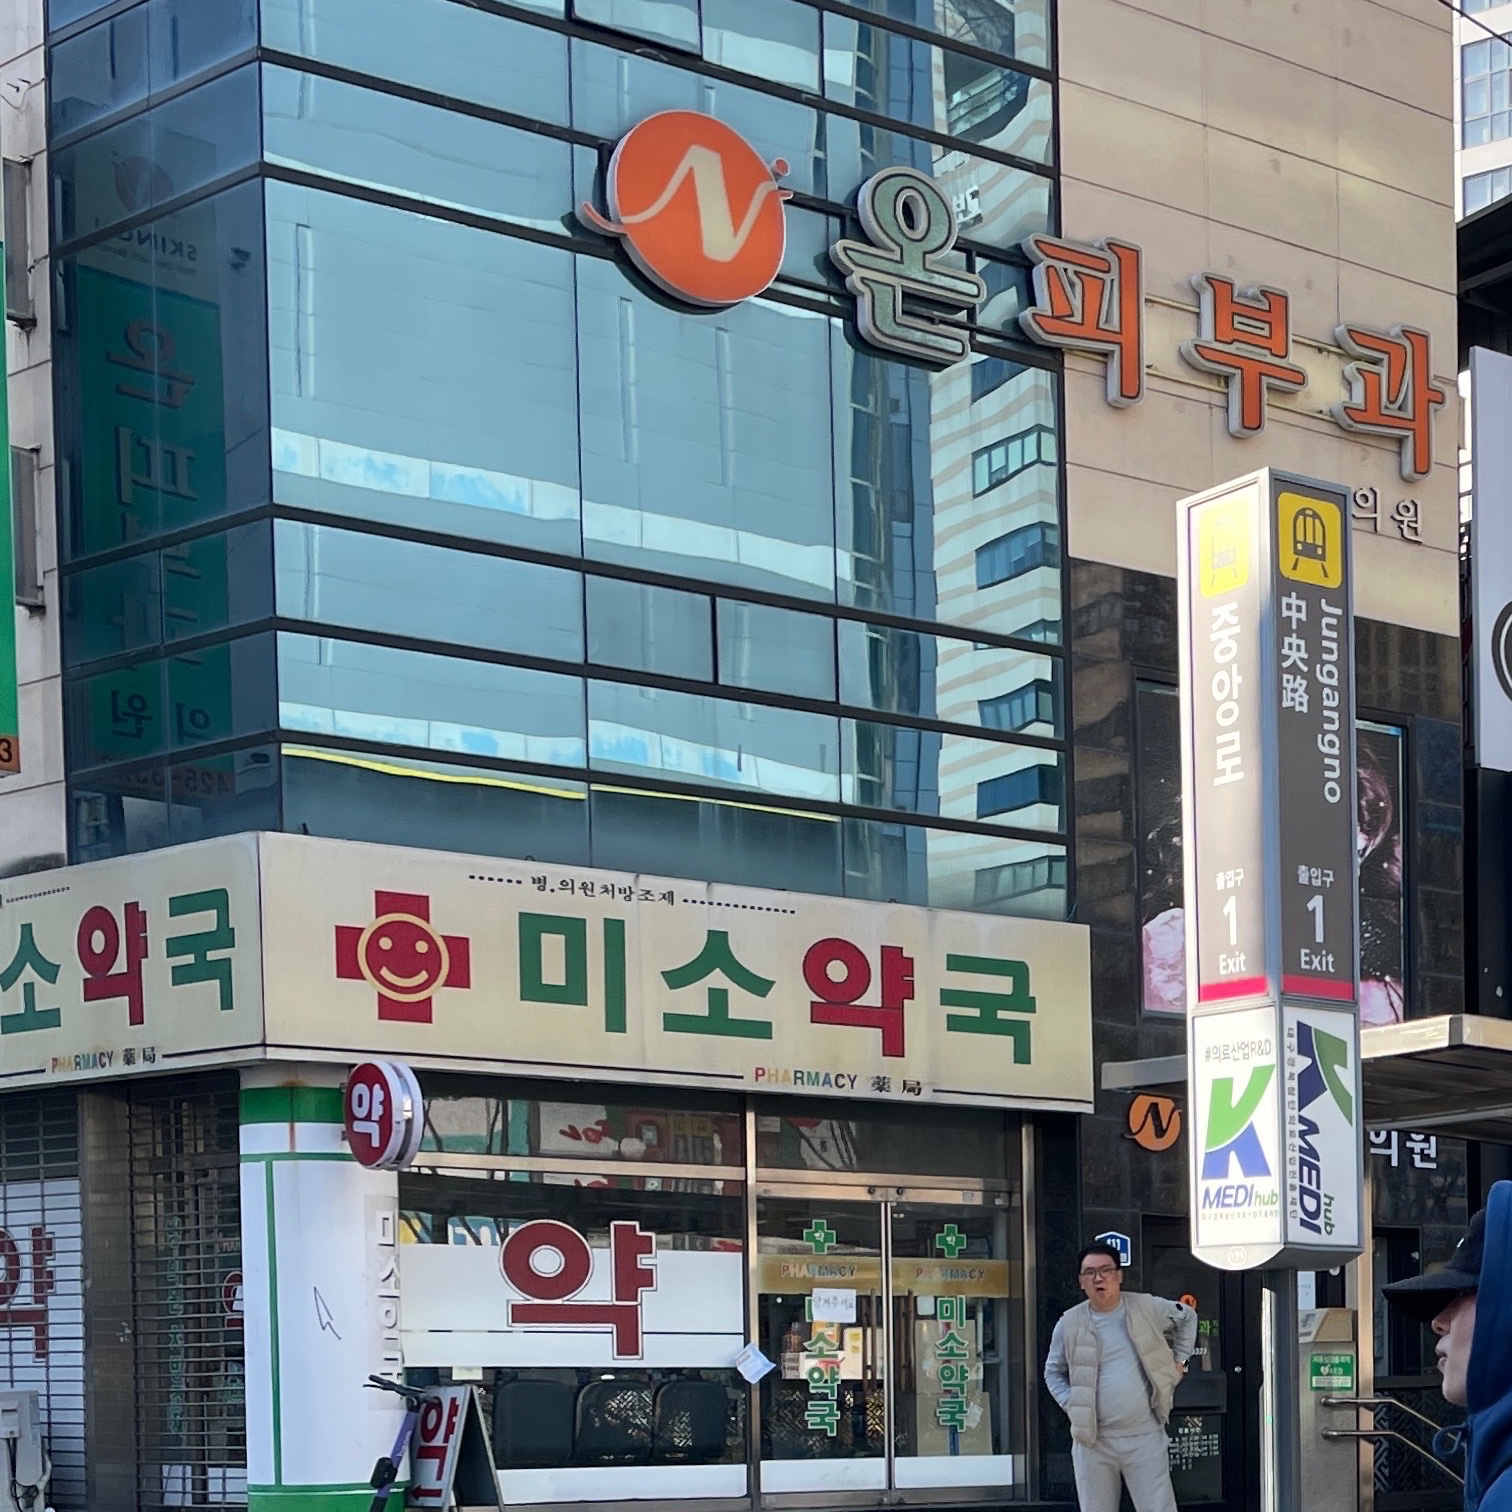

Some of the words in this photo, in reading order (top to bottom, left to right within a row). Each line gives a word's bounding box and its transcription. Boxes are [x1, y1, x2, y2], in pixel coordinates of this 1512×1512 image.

[1352, 487, 1422, 544] 의원
[1281, 592, 1308, 713] 中央路
[1210, 601, 1244, 787] 중앙로
[1315, 599, 1343, 804] Jungangno
[1215, 868, 1245, 890] 출입구
[1297, 865, 1334, 888] 출입구
[1223, 896, 1237, 945] 1
[1307, 895, 1324, 943] 1
[1219, 953, 1246, 974] Exit
[1300, 949, 1335, 973] Exit
[519, 911, 1036, 1065] 미소약국
[51, 1050, 113, 1074] PHARMACY
[755, 1067, 857, 1089] PHARMACY
[350, 1082, 385, 1148] 약
[1298, 1114, 1322, 1236] MEDI
[1369, 1130, 1438, 1169] 의원
[1323, 1193, 1335, 1236] hub
[502, 1219, 657, 1360] 약
[915, 1266, 986, 1280] PHRMACY
[803, 1295, 842, 1436] 소약국
[936, 1294, 969, 1433] 미소약국
[416, 1395, 461, 1481] 약
